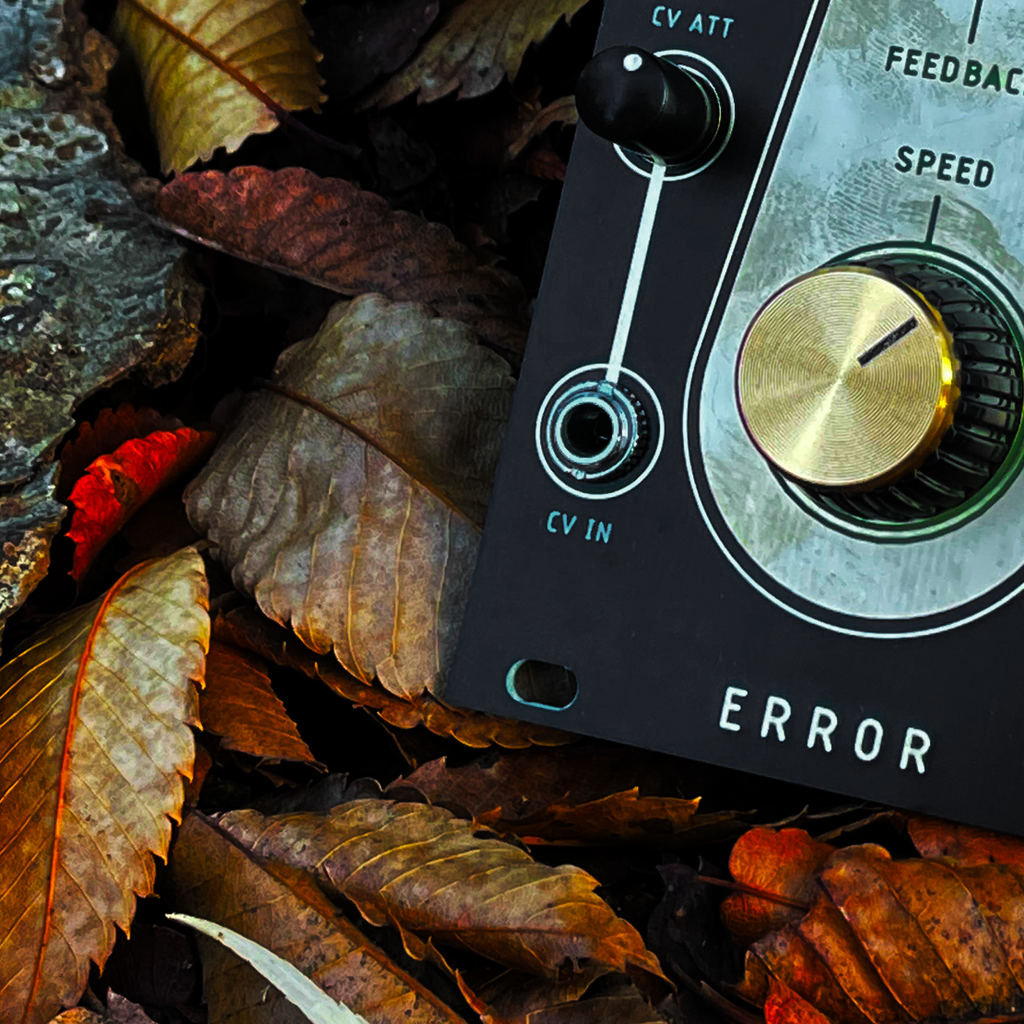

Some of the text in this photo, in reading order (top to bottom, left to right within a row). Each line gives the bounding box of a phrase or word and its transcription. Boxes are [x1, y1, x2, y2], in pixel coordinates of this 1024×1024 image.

[651, 5, 735, 39] CV ATT
[894, 145, 995, 188] SPEED
[546, 510, 613, 544] CV IN
[719, 686, 931, 774] ERROR
